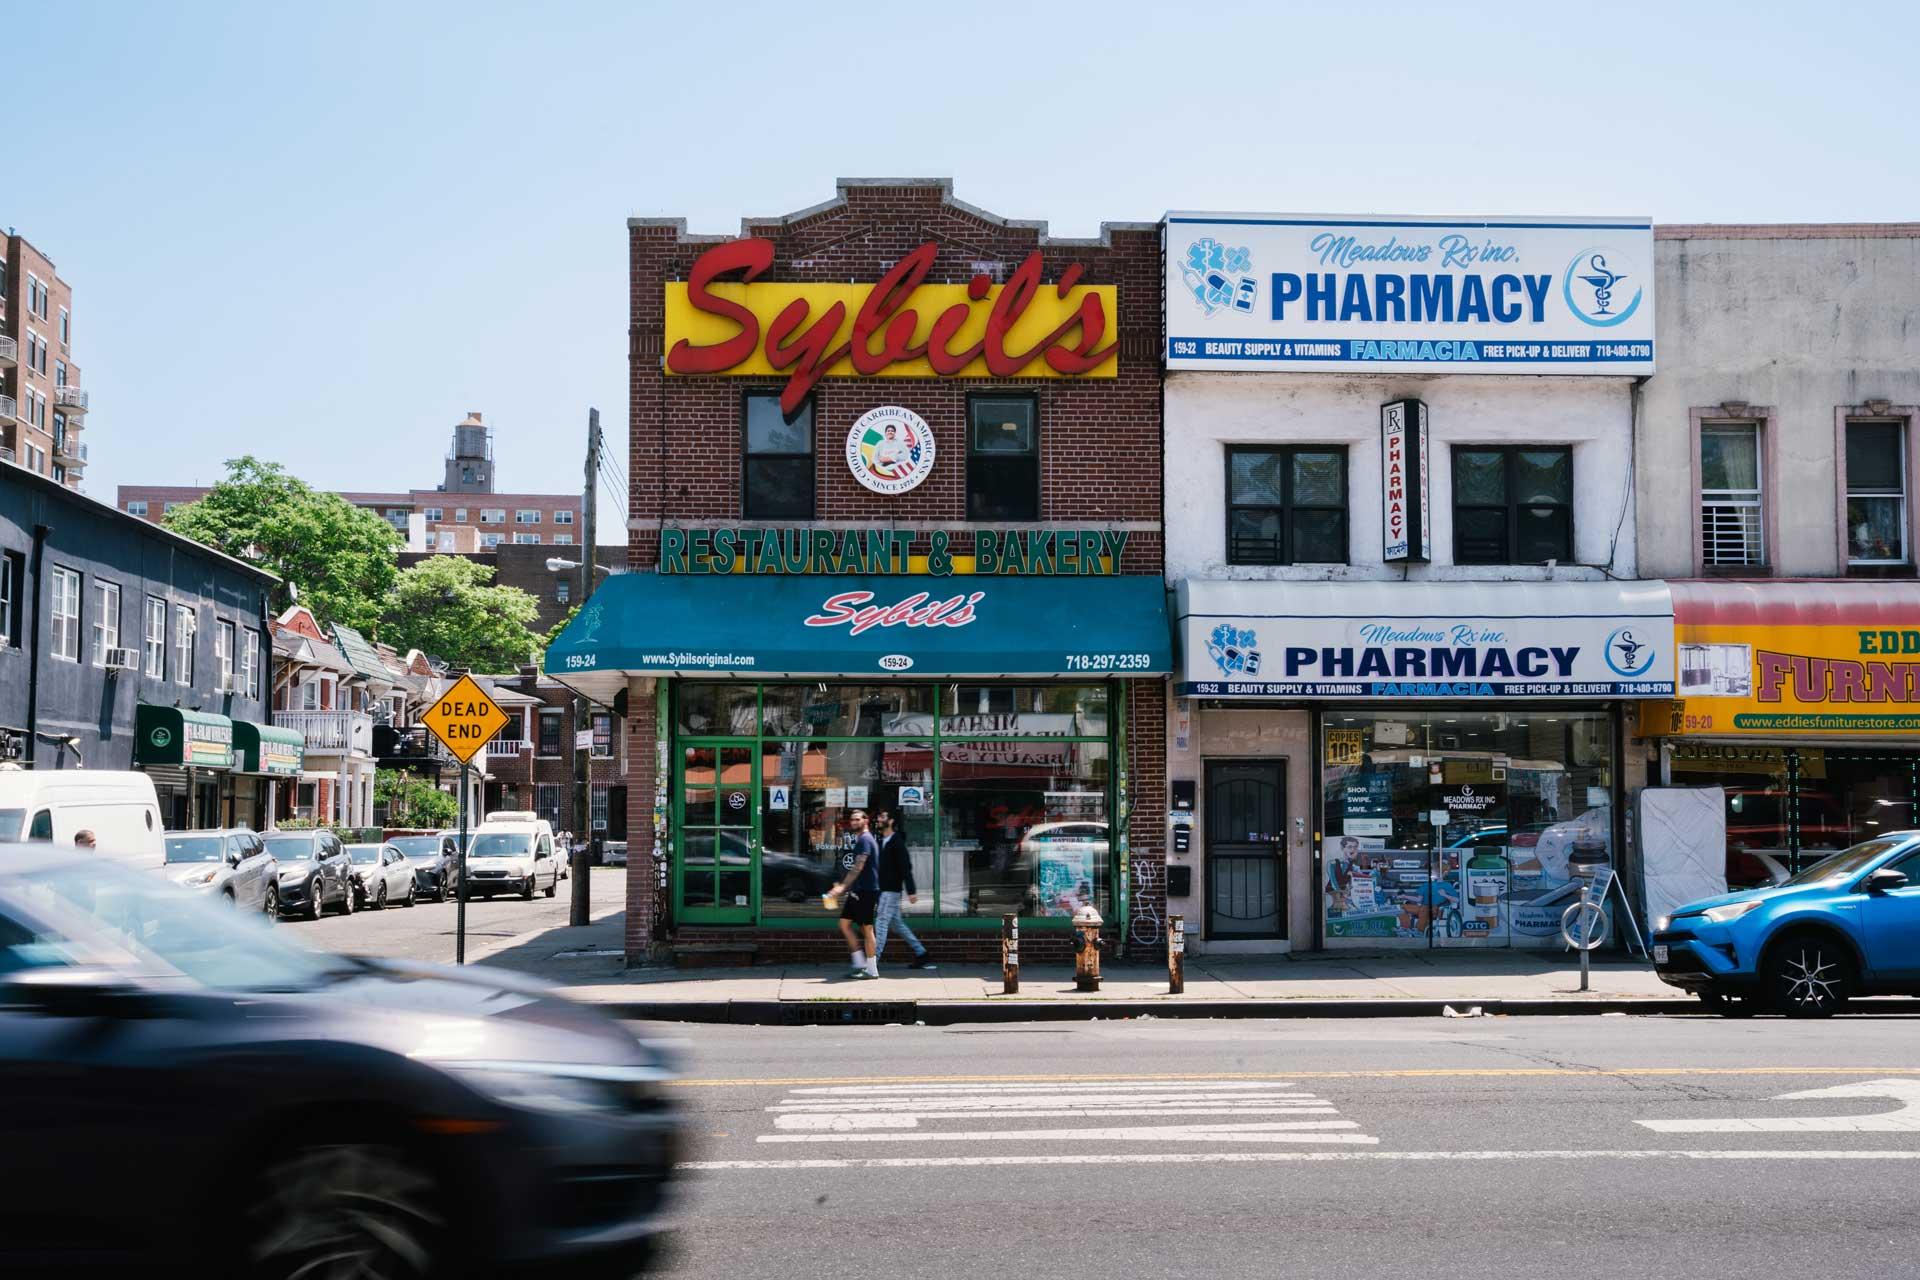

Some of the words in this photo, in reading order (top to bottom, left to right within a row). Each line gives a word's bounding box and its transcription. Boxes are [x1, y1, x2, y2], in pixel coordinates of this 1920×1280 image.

[1311, 232, 1432, 266] Meadows
[1439, 234, 1478, 268] Rx
[1271, 273, 1553, 323] PHARMACY
[667, 237, 1120, 415] Sybil's
[1174, 342, 1197, 355] 159-22
[1205, 342, 1243, 355] BEAUTY
[1245, 343, 1282, 356] SUPPLY
[1284, 344, 1292, 356] &
[1294, 344, 1342, 357] VITAMINS
[1350, 341, 1480, 361] FARMACIA
[1483, 345, 1504, 358] FREE
[1506, 345, 1541, 358] PICK-UP
[1543, 346, 1550, 358] &
[1552, 345, 1591, 358] DELIVERY
[1596, 345, 1651, 358] 718-480-8790
[1389, 409, 1401, 432] Rx
[852, 427, 862, 440] OF
[914, 421, 932, 475] AMERICANS
[850, 442, 867, 479] CHOICE
[872, 480, 898, 491] SINCE
[1389, 437, 1402, 539] PHARMACY
[661, 528, 915, 575] RESTAURANT
[927, 529, 954, 576] &
[975, 529, 1129, 575] BAKERY
[804, 591, 986, 636] Sybil's
[1360, 623, 1444, 646] Meadows
[1450, 624, 1476, 646] Rx
[1858, 631, 1920, 654] EDD
[565, 654, 596, 668] 159-24
[642, 652, 755, 668] www.Sybilsoriginal.com
[883, 657, 908, 668] 159-24
[1066, 654, 1151, 670] 718-297-2359
[1286, 647, 1581, 677] PHARMACY
[1196, 683, 1219, 693] 159-22
[1228, 684, 1265, 694] BEAUTY
[1267, 684, 1302, 694] SUPPLY
[1305, 685, 1313, 694] &
[1316, 684, 1362, 694] VITAMINS
[1371, 682, 1496, 696] FARMACIA
[1504, 684, 1525, 694] FREE
[1527, 684, 1561, 694] PICK-UP
[1563, 684, 1571, 694] &
[1573, 684, 1612, 694] DELIVERY
[1619, 683, 1672, 693] 718-480-8790
[441, 702, 489, 717] DEAD
[447, 724, 482, 739] END
[1329, 732, 1359, 742] COPIES
[773, 789, 785, 803] A
[1443, 796, 1475, 804] MEADOWS
[1475, 796, 1483, 804] RX
[1484, 796, 1496, 804] INC
[1466, 922, 1488, 930] OTC
[1515, 919, 1562, 929] PHARMAC
